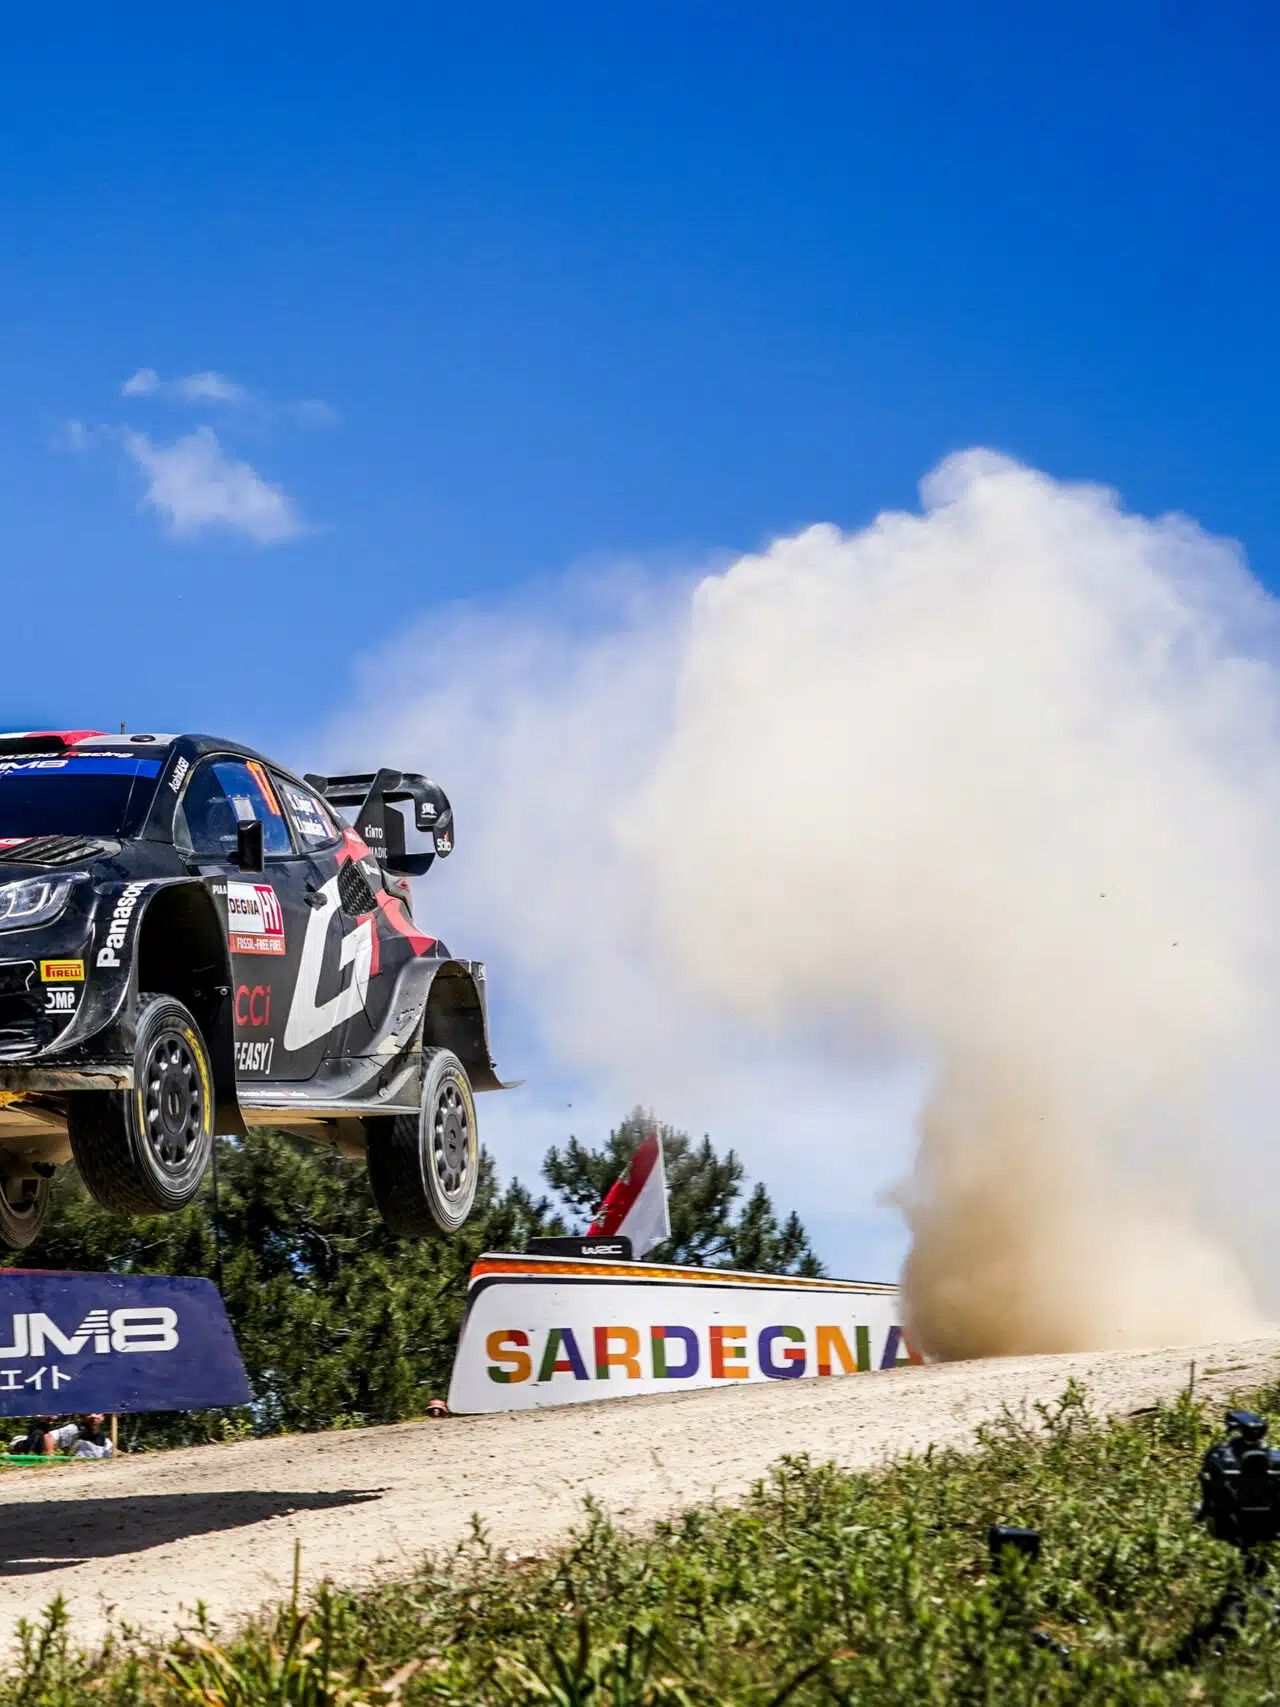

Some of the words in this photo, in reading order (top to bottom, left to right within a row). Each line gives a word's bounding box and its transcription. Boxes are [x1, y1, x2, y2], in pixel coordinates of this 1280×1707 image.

[228, 898, 260, 916] DEGNA
[45, 964, 81, 977] PIRELLI
[581, 1245, 623, 1254] WRC
[485, 1325, 925, 1384] SARDEGNA
